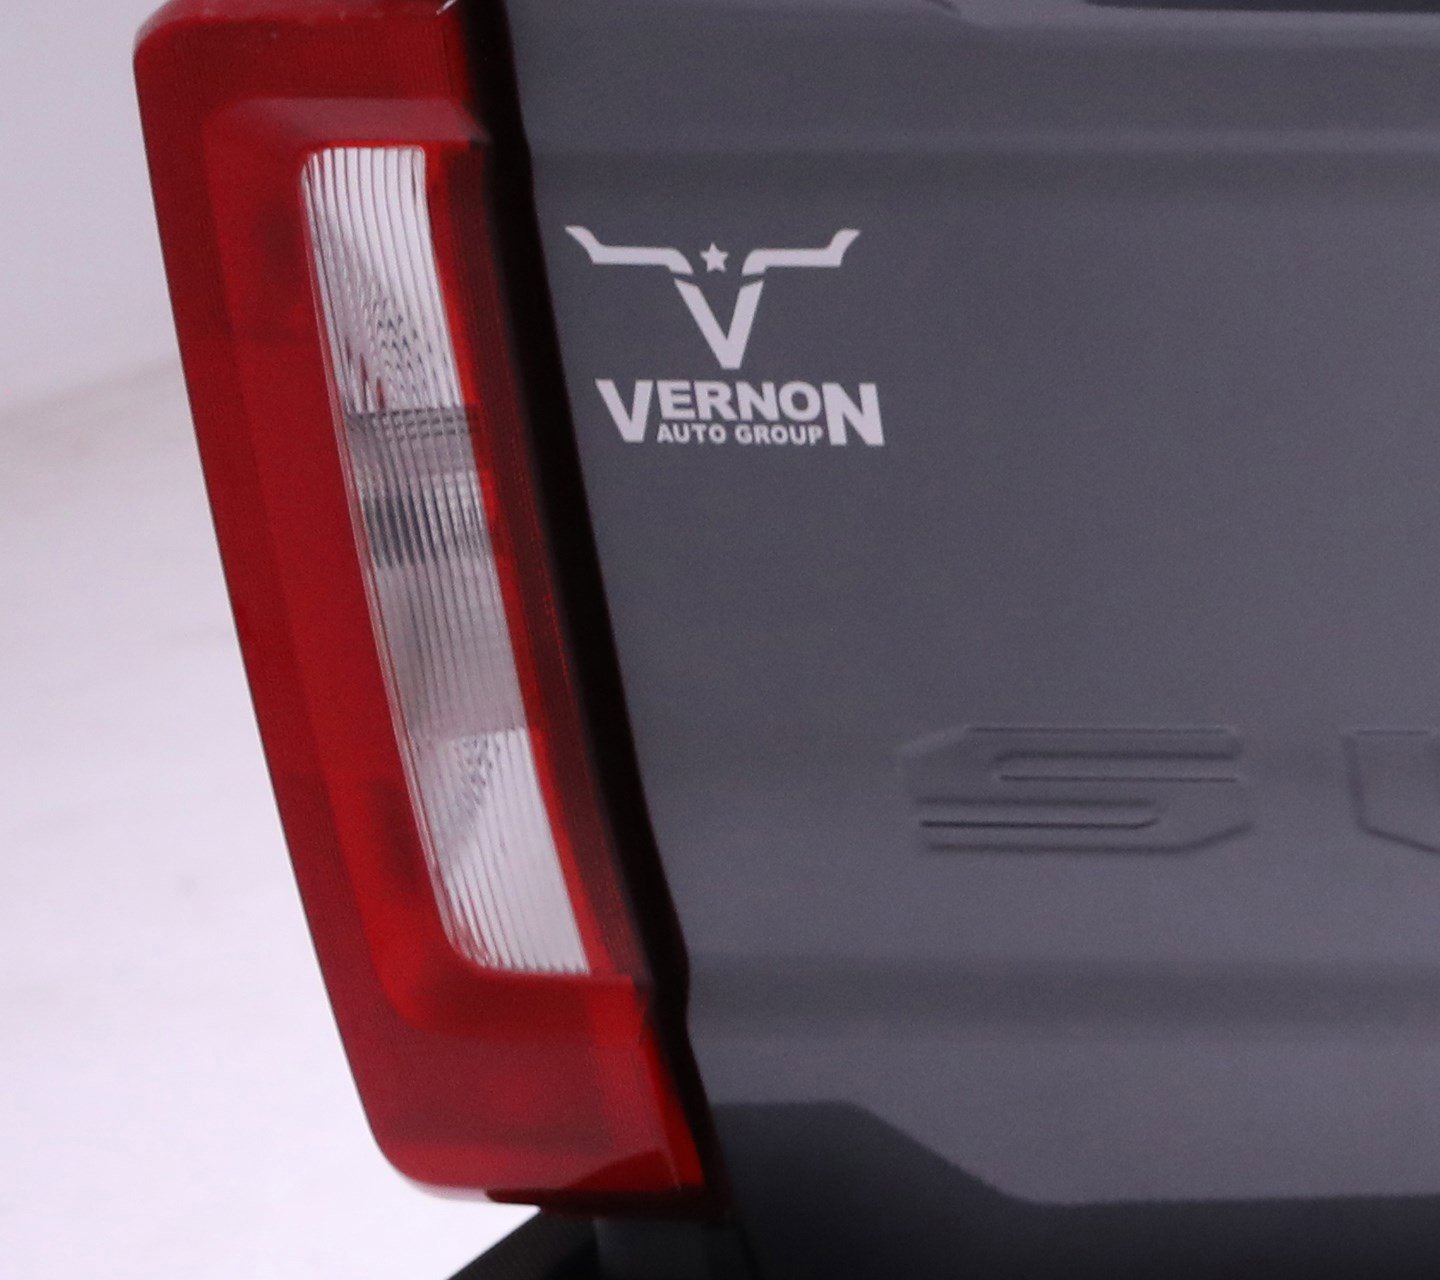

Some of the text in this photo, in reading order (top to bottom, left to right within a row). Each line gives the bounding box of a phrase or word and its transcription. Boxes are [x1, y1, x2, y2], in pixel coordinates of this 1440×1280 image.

[595, 378, 885, 446] VERNON
[656, 423, 824, 446] AUTO GROUP
